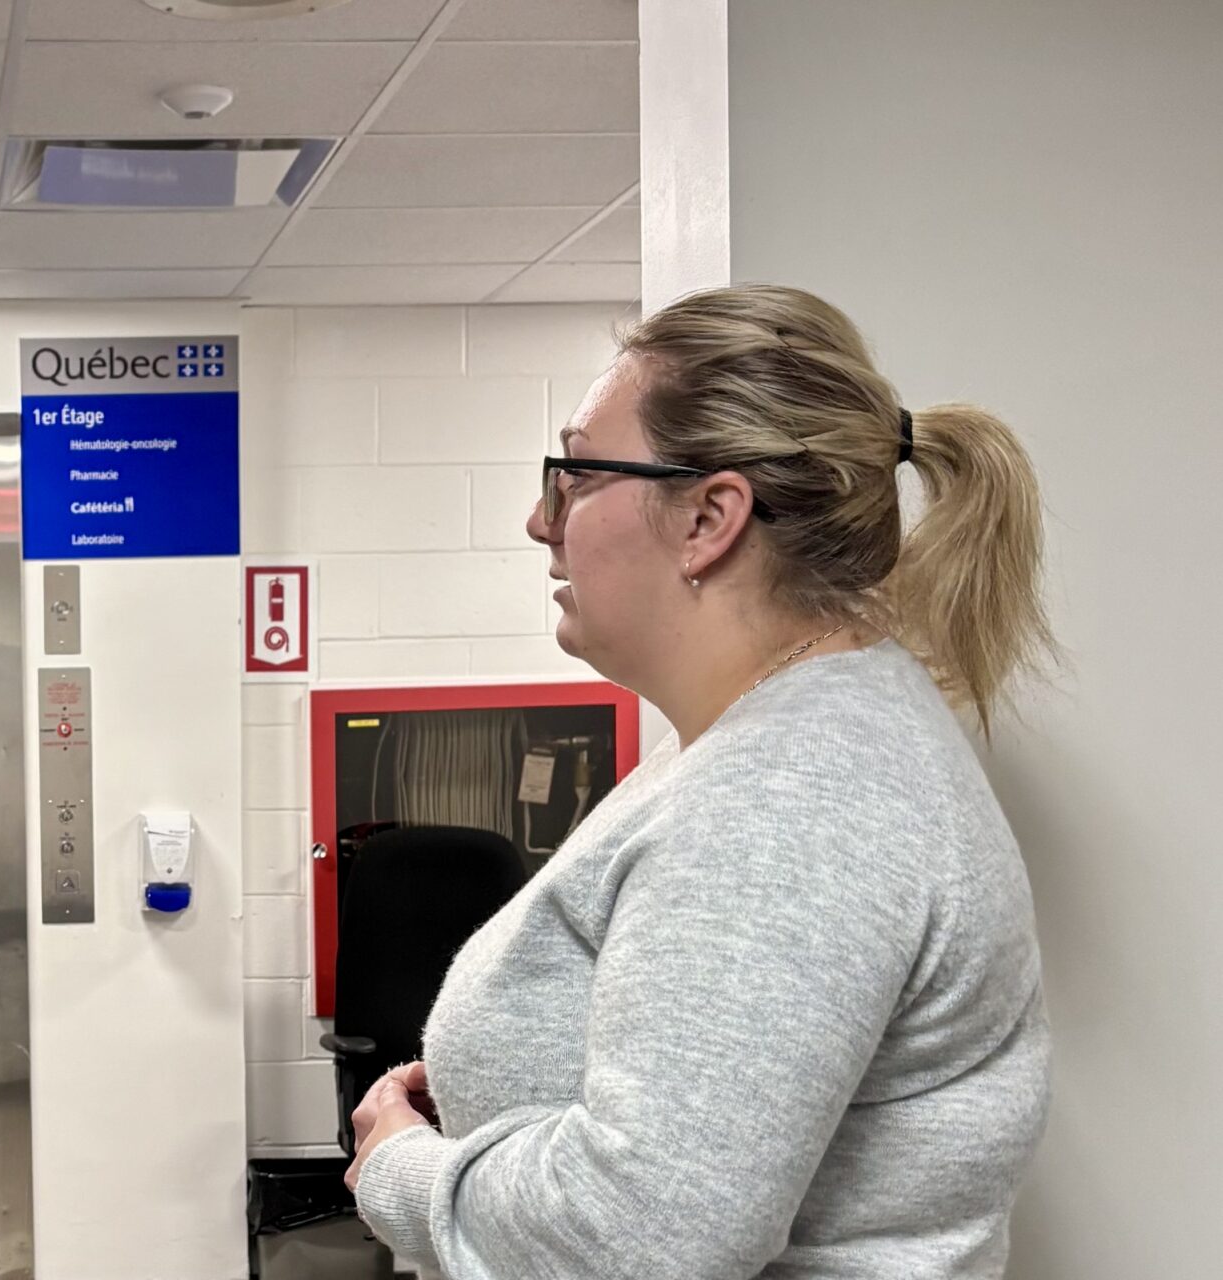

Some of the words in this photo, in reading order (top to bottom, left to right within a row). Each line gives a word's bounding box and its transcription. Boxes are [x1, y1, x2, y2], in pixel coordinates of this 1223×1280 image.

[31, 346, 171, 387] Québec
[33, 407, 58, 425] 1er
[61, 404, 105, 428] Étage
[70, 438, 177, 452] Hématologie-oncologie
[70, 469, 119, 481] Pharmacie
[70, 500, 124, 514] Cafétéria
[71, 533, 125, 546] Laboratoire
